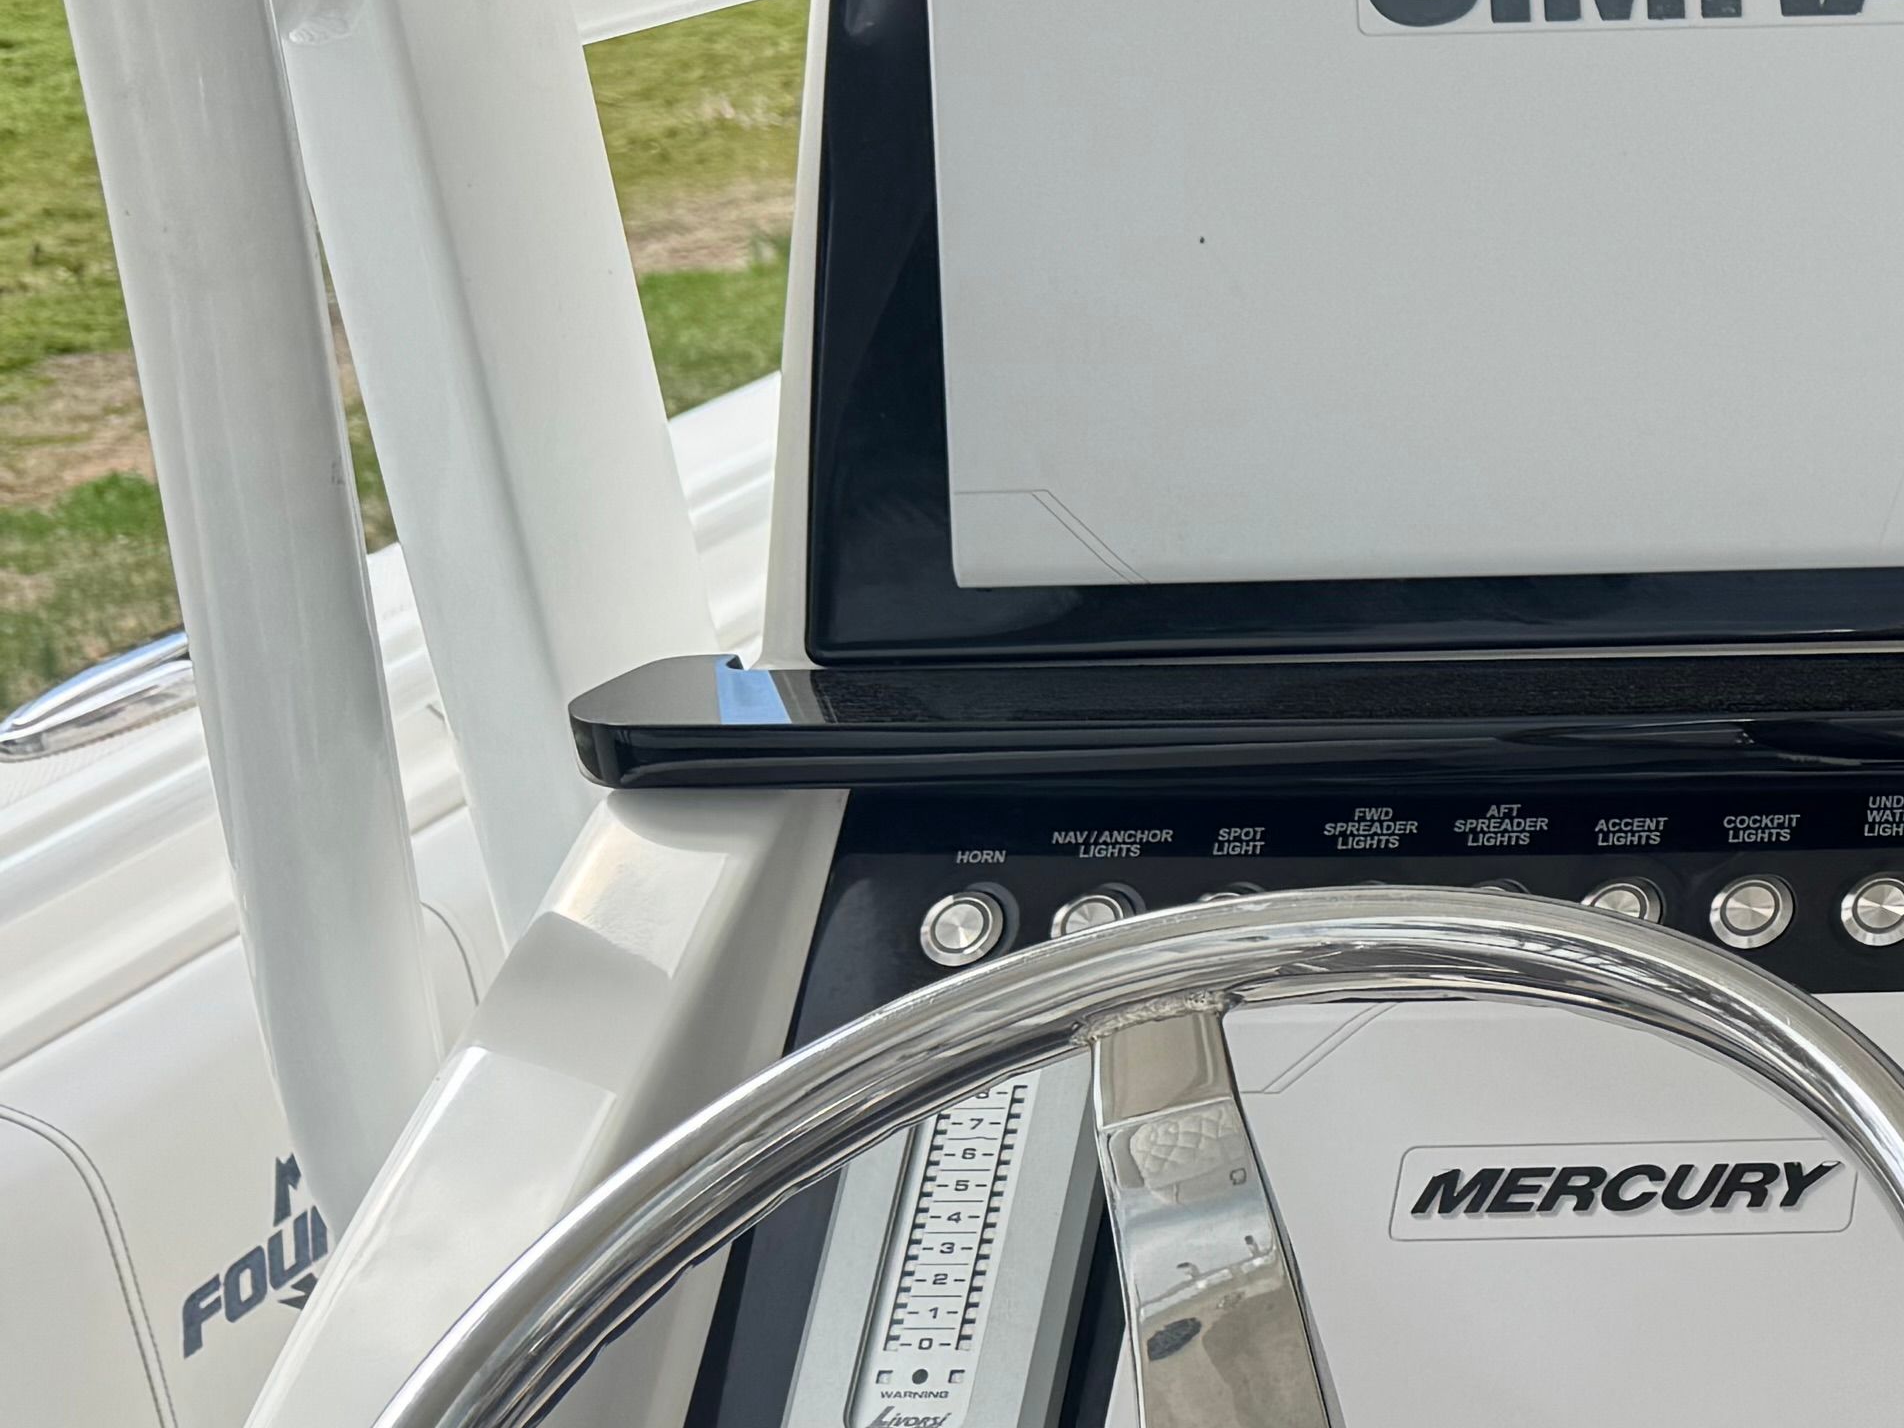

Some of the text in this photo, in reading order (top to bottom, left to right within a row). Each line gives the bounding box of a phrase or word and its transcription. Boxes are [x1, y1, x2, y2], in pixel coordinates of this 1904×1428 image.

[1354, 808, 1393, 821] FWD
[1487, 804, 1521, 817] AFT
[1324, 821, 1418, 835] SPREADER
[1454, 818, 1548, 833] SPREADER
[1595, 817, 1667, 832] ACCENT
[1723, 814, 1801, 829] COCKPIT
[1052, 831, 1088, 844] NAV
[1099, 829, 1174, 843] ANCHOR
[1217, 828, 1265, 841] SPOT
[1467, 832, 1530, 847] LIGHTS
[1597, 831, 1661, 846] LIGHTS
[1728, 828, 1791, 843] LIGHTS
[1213, 841, 1265, 855] LIGHT
[1337, 835, 1400, 850] LIGHTS
[956, 850, 1006, 863] HORN
[1079, 844, 1141, 858] LIGHTS
[969, 1118, 985, 1130] 7
[961, 1148, 977, 1160] 6
[954, 1179, 970, 1191] 5
[1411, 1160, 1843, 1214] MERCURY
[947, 1211, 963, 1223] 4
[939, 1242, 955, 1255] 3
[933, 1274, 948, 1285] 2
[929, 1307, 939, 1319] 1
[880, 1390, 950, 1399] WARNING
